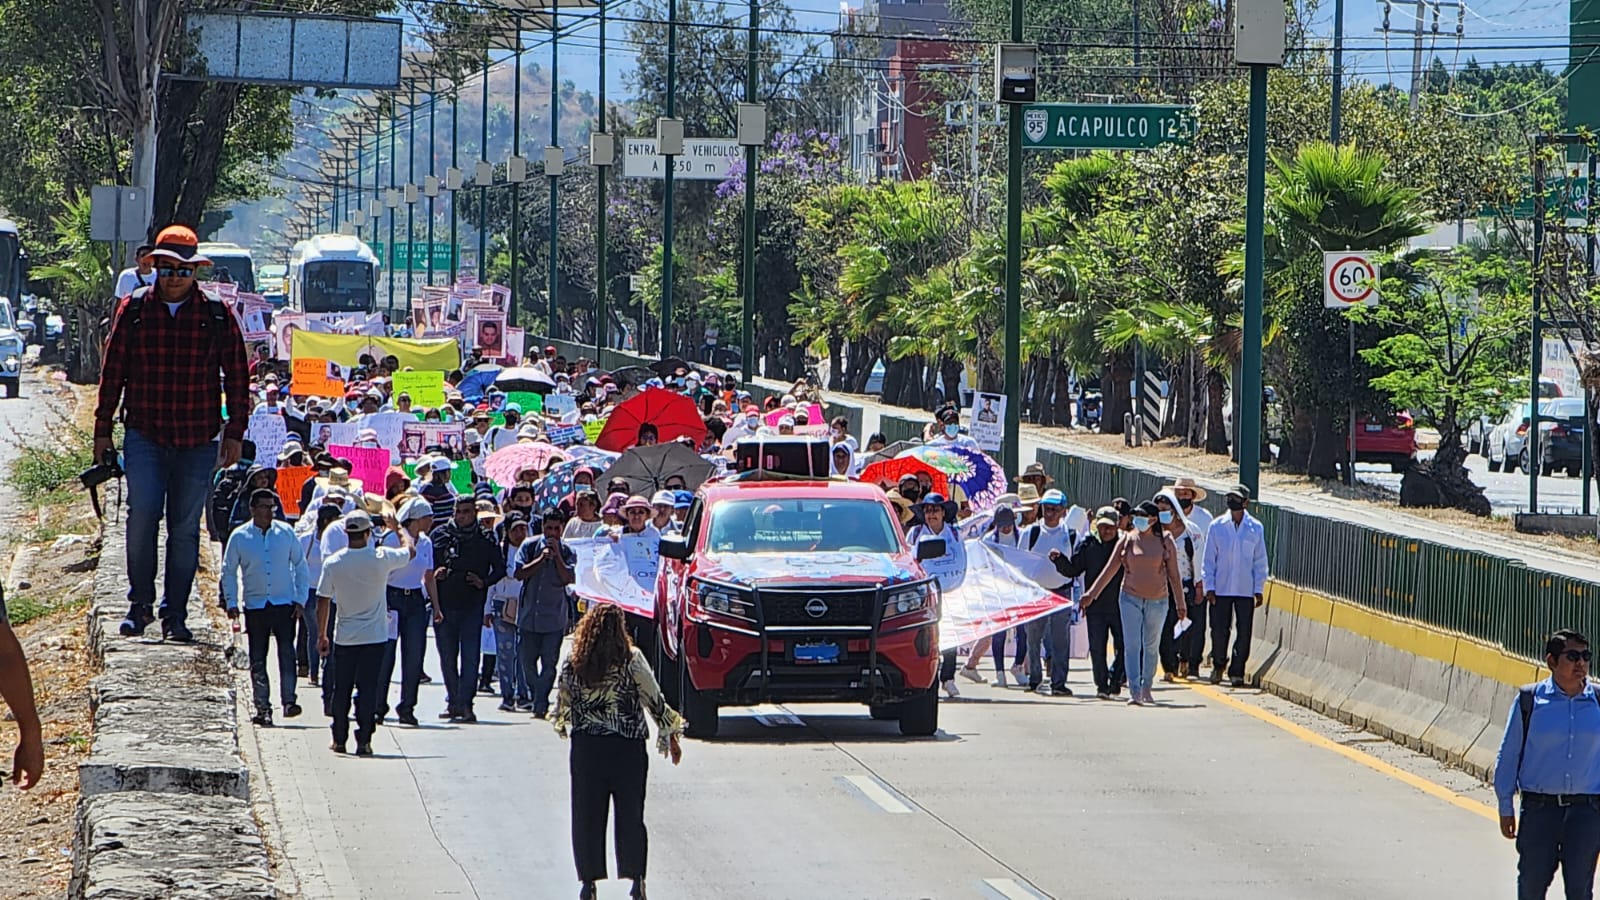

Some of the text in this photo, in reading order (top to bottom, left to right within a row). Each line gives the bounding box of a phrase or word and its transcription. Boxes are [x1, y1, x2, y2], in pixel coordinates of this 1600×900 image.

[1029, 121, 1044, 133] 95
[1056, 116, 1148, 138] ACAPULCO
[692, 144, 740, 157] VEHICULOS
[652, 161, 659, 172] A
[704, 163, 716, 173] m
[1339, 266, 1365, 286] 60
